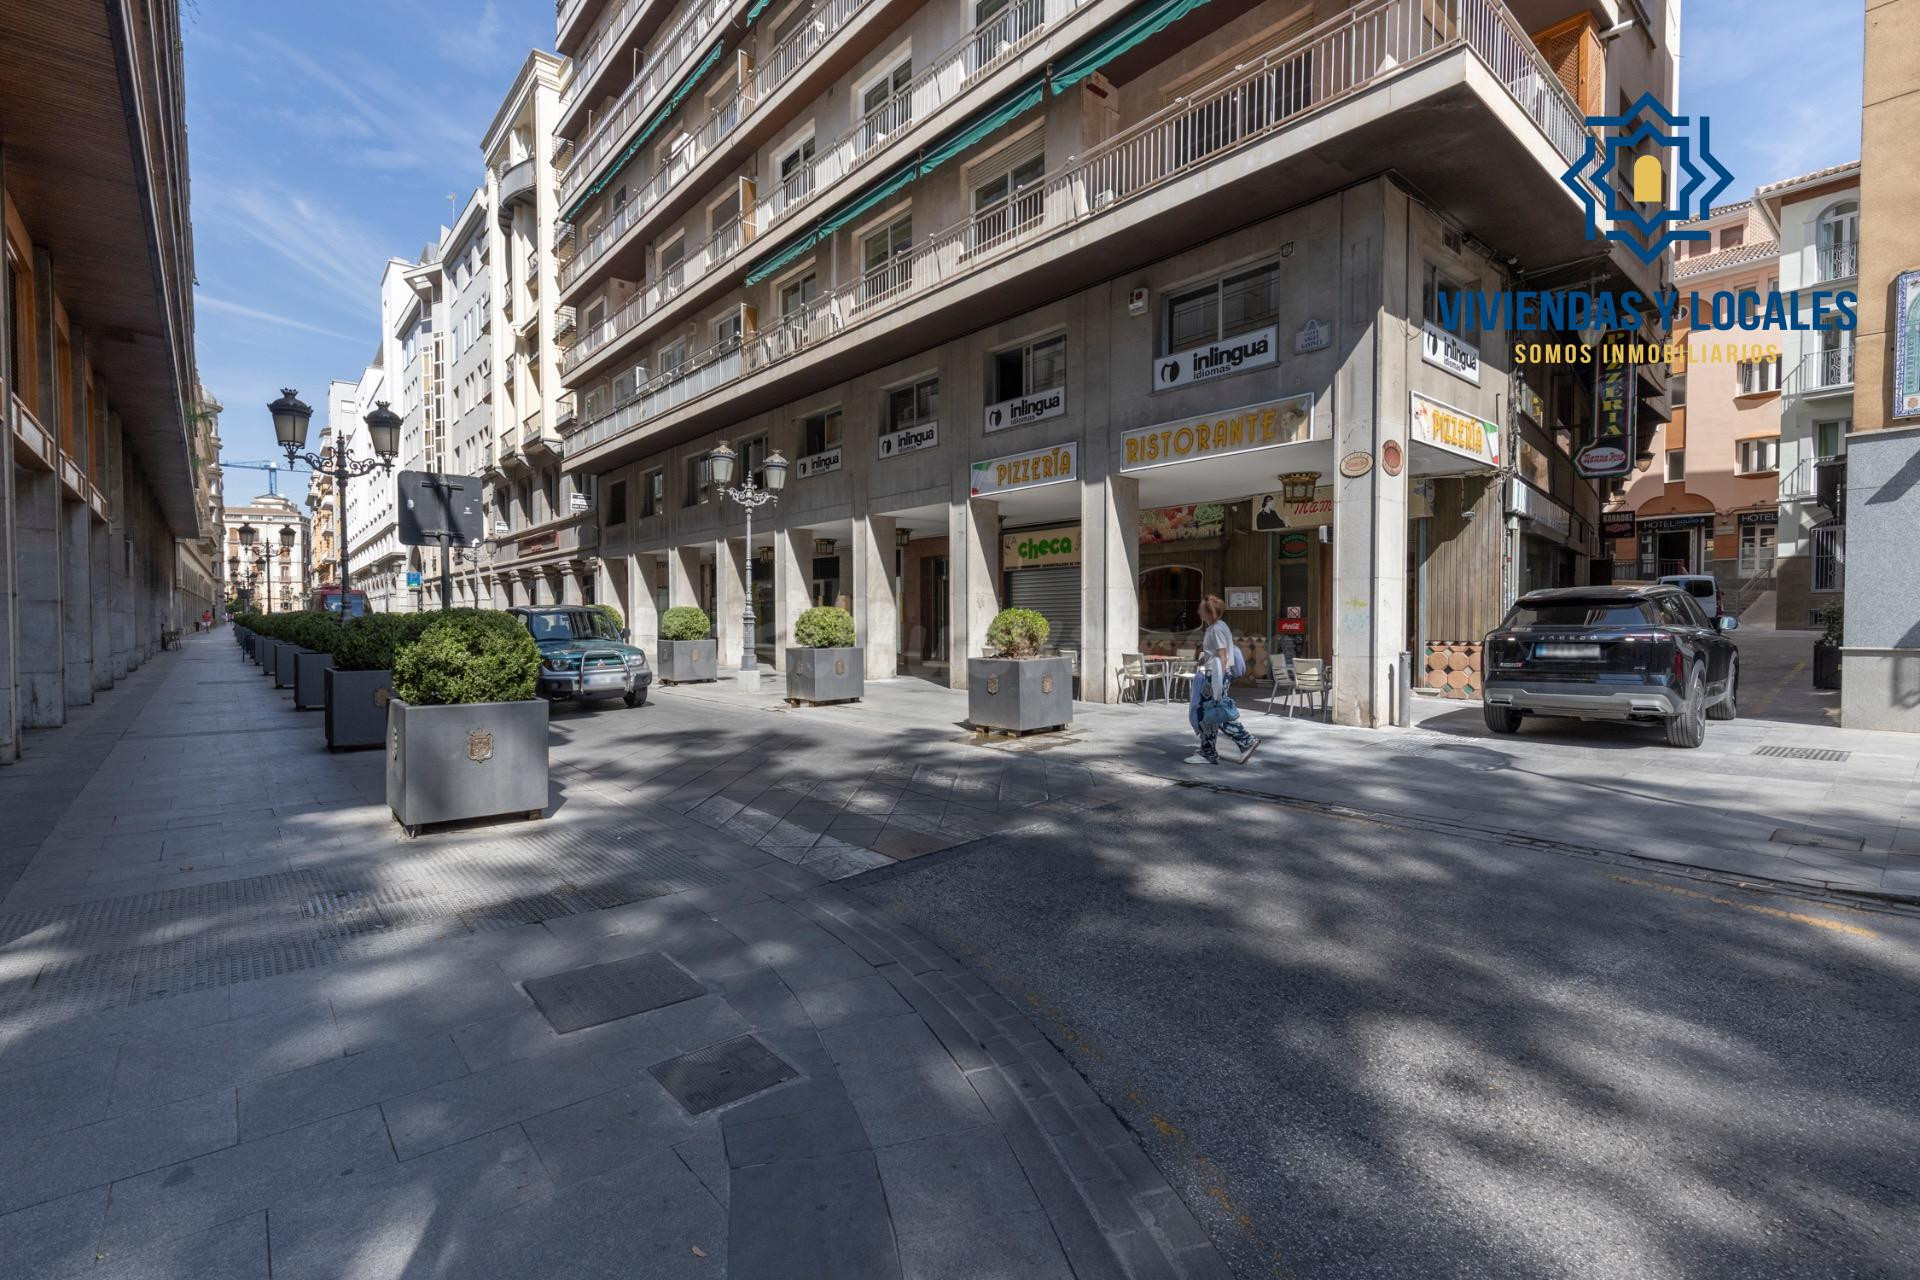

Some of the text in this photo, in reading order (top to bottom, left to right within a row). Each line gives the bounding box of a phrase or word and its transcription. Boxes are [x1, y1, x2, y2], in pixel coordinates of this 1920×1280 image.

[1193, 339, 1269, 367] inlingua
[1444, 336, 1477, 371] inlingua
[1193, 364, 1231, 380] idiomas
[1602, 328, 1624, 437] PZZERIA
[1010, 395, 1060, 416] inlingua
[897, 429, 935, 446] inlingua
[1125, 409, 1278, 465] RISTORANTE
[811, 455, 839, 470] inlingua
[1643, 521, 1675, 530] HOTEL
[1741, 513, 1778, 522] HOTEL
[1018, 536, 1072, 560] checa
